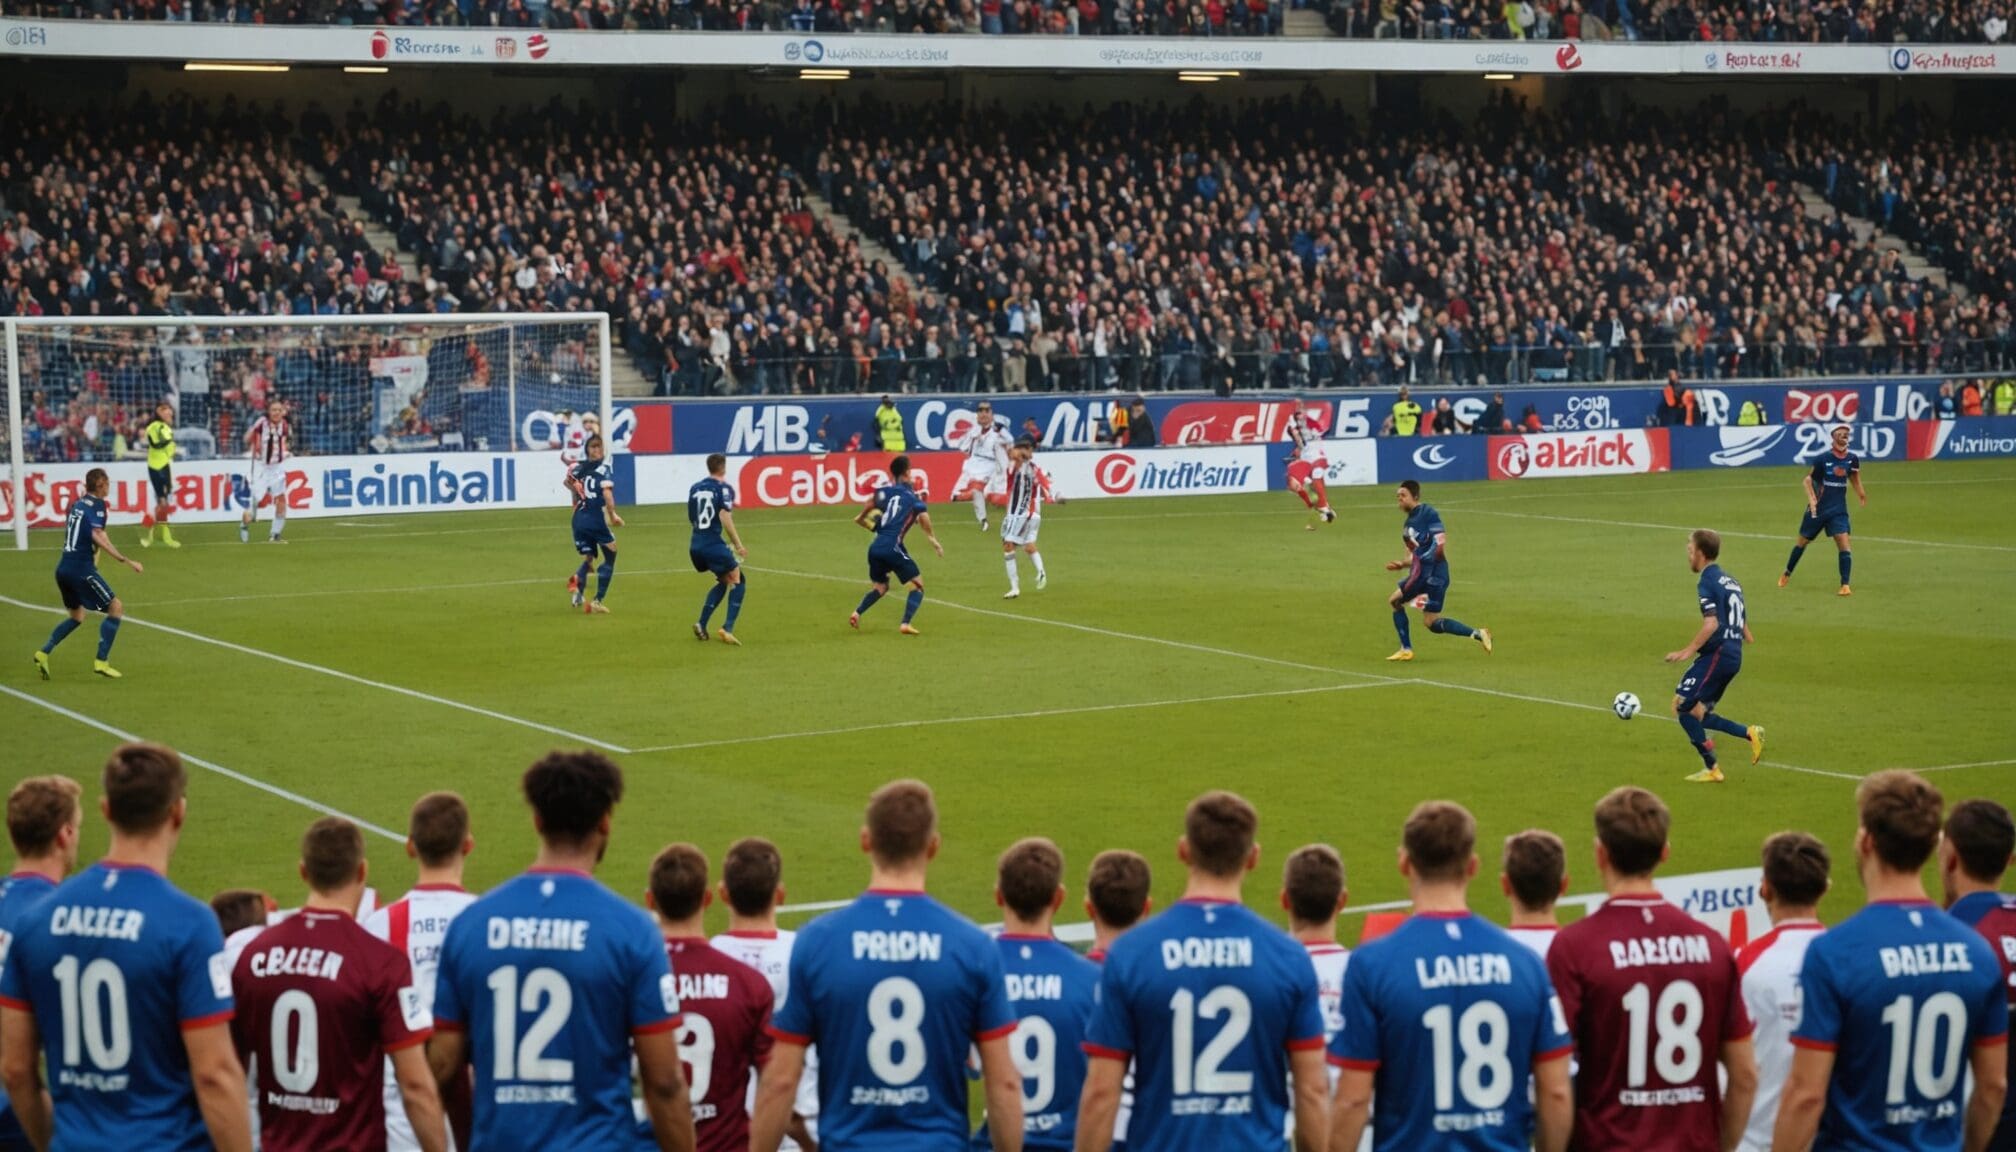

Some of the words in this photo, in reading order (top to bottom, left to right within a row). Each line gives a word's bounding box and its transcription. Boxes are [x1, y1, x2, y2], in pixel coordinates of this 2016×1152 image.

[52, 954, 132, 1071] 10
[270, 989, 319, 1094] 0
[487, 964, 574, 1082] 12
[674, 1011, 716, 1105] 9
[867, 975, 927, 1086] 8
[1007, 1015, 1057, 1114] 9
[1169, 984, 1254, 1096] 12
[1422, 1000, 1514, 1111] 18
[1621, 979, 1704, 1089] 18
[1881, 981, 1968, 1105] 10
